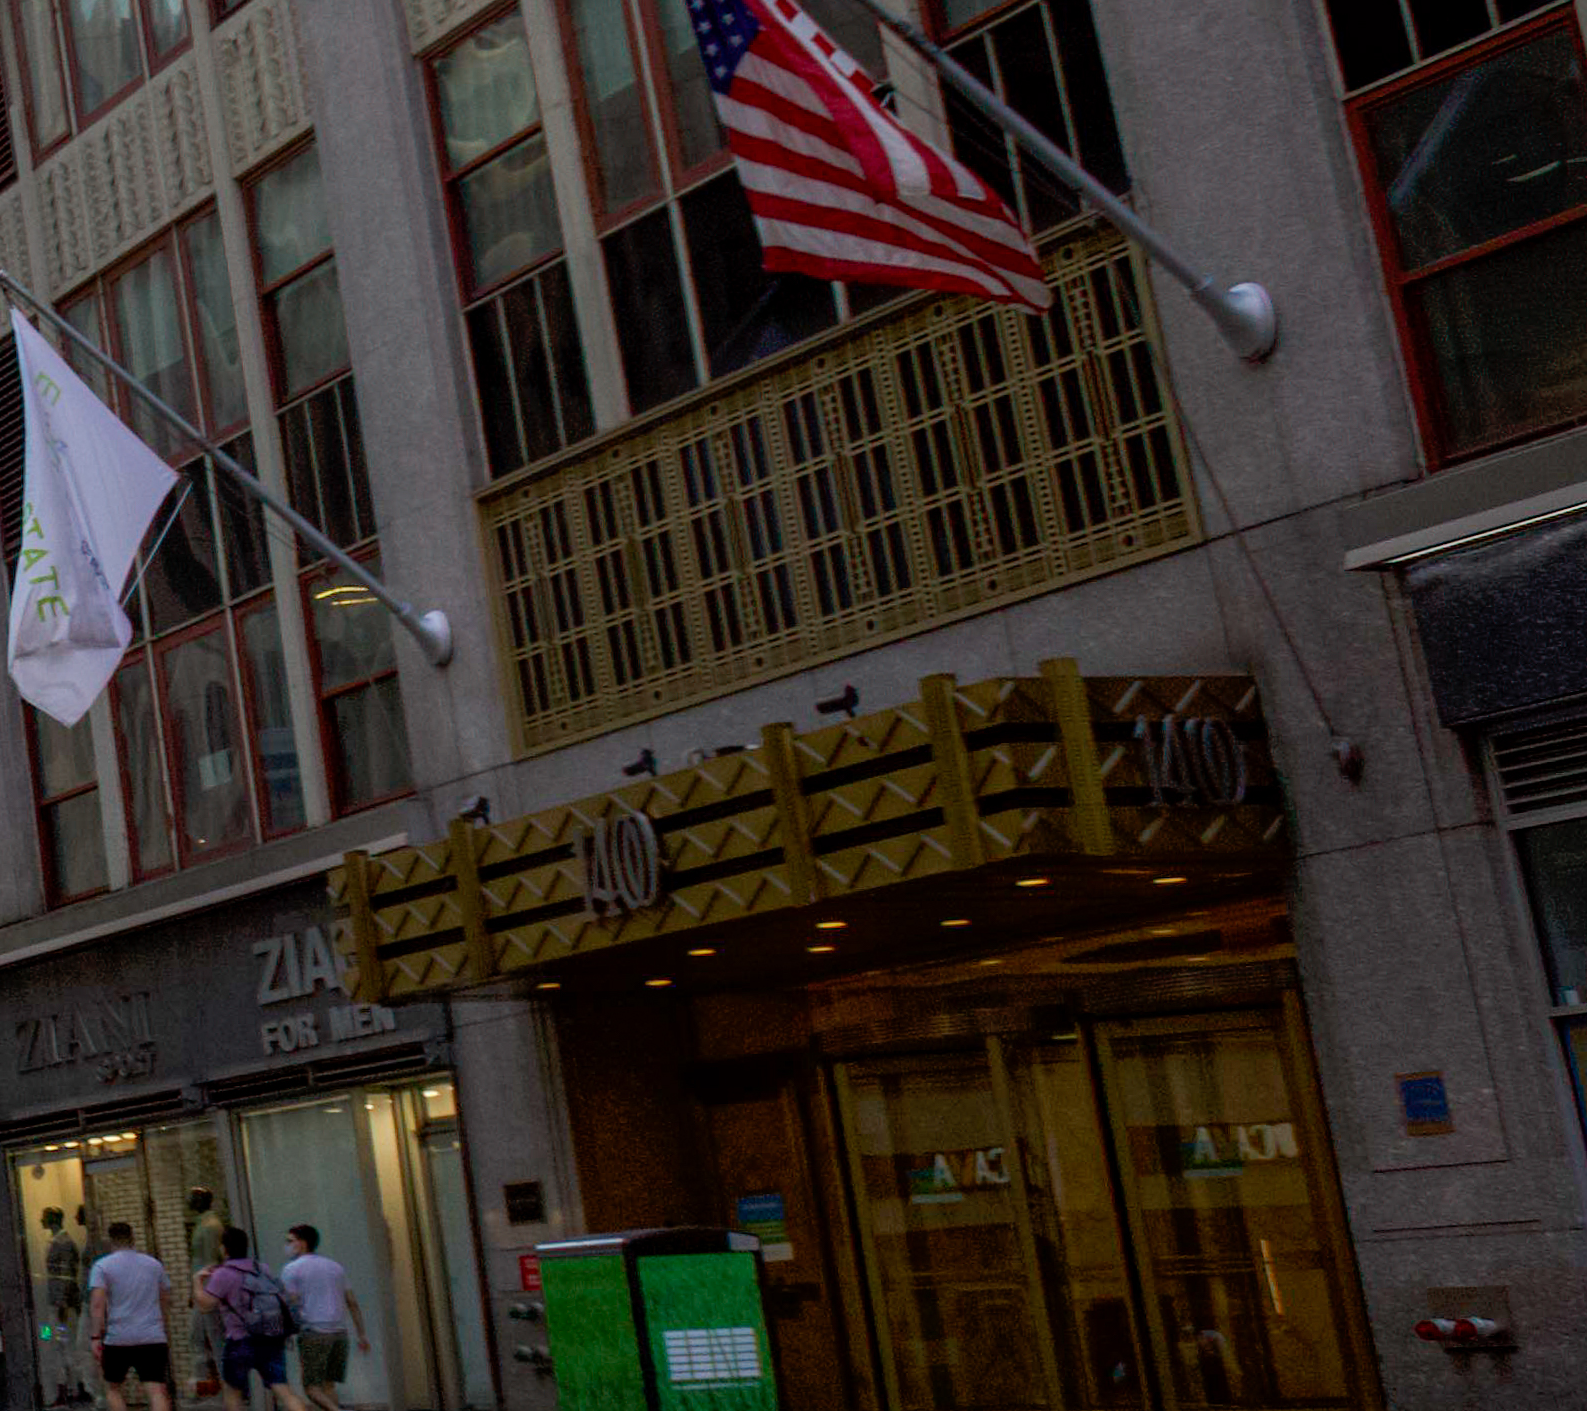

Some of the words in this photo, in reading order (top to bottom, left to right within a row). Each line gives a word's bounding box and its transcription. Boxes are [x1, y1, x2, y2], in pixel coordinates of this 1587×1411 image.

[16, 991, 155, 1075] ZIANI
[262, 1013, 319, 1057] FOR
[329, 1003, 396, 1042] MEN
